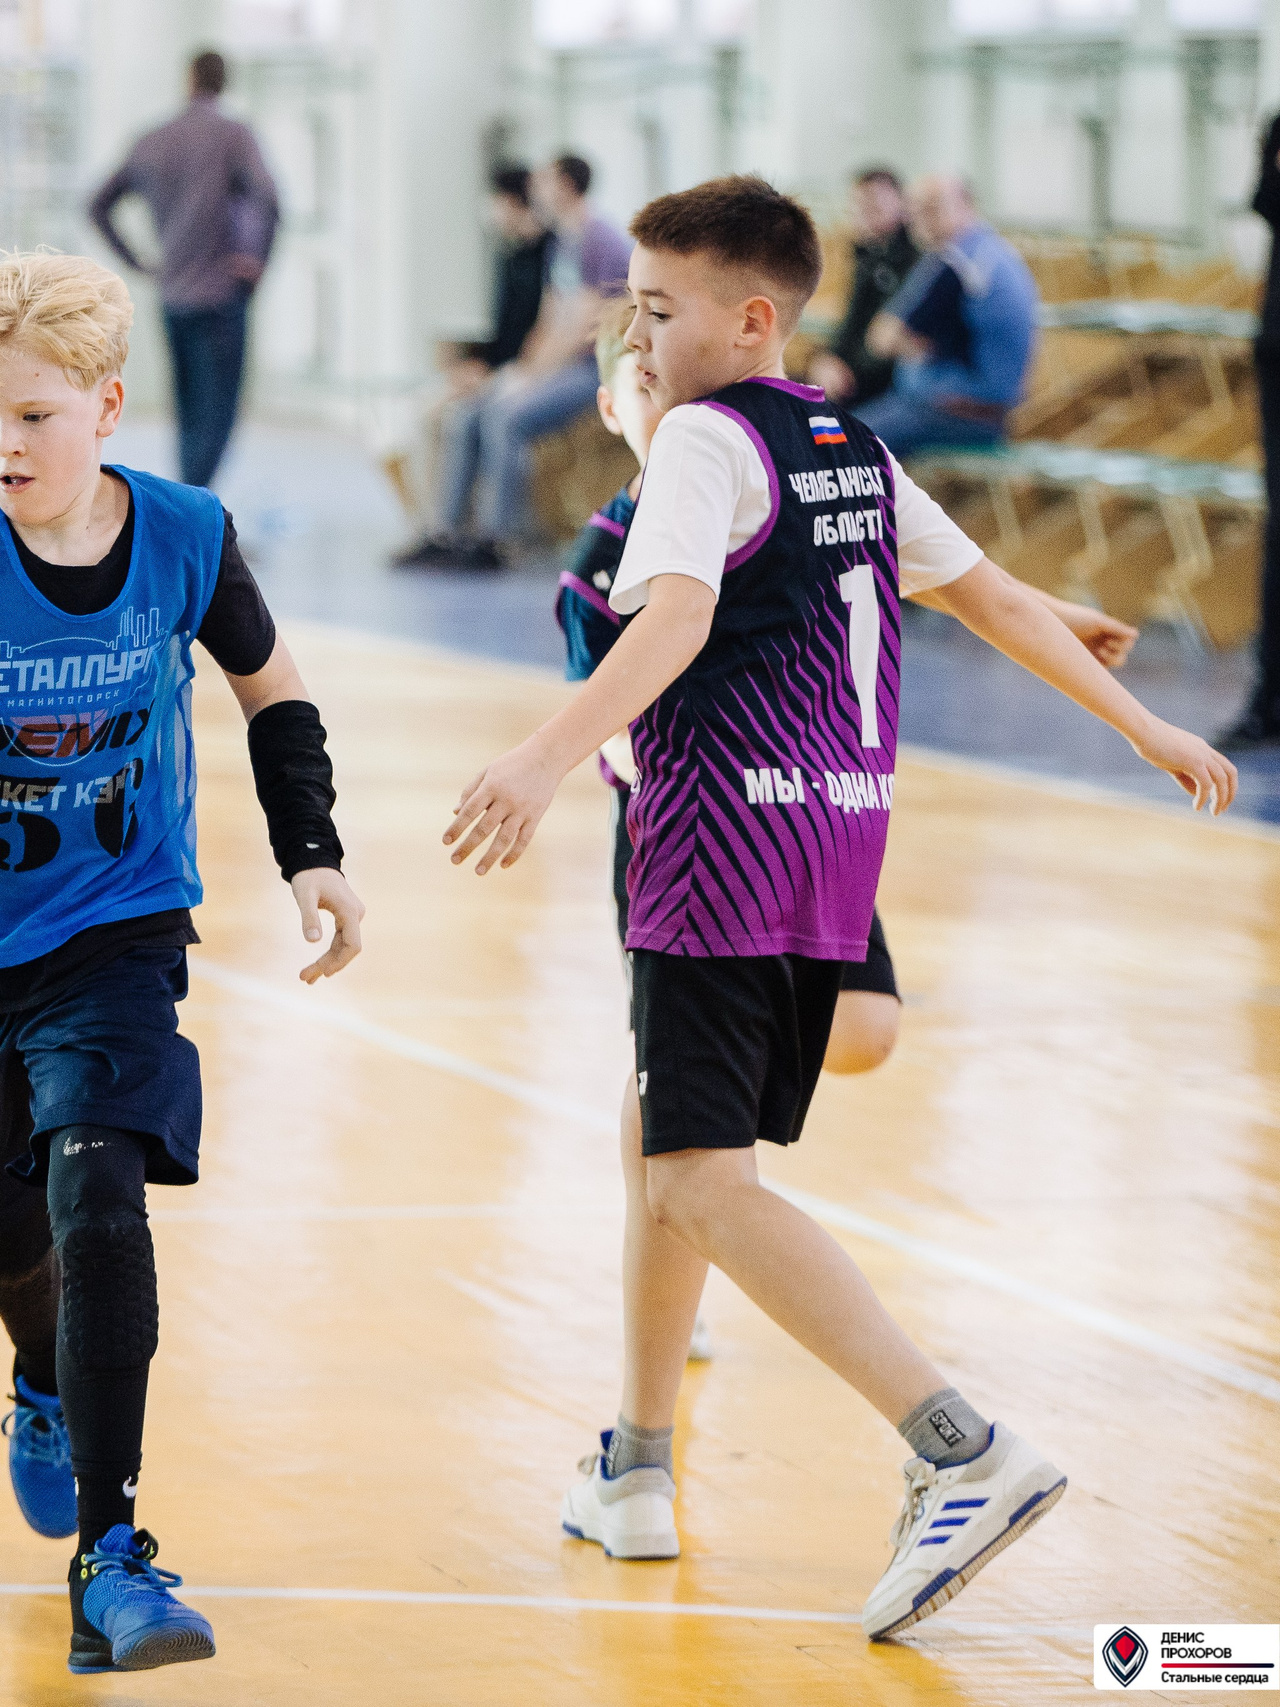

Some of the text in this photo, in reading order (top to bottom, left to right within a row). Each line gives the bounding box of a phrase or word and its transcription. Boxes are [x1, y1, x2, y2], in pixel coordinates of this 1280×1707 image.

[838, 564, 881, 748] 1
[743, 767, 806, 805] МЫ
[824, 770, 880, 814] ОДНА
